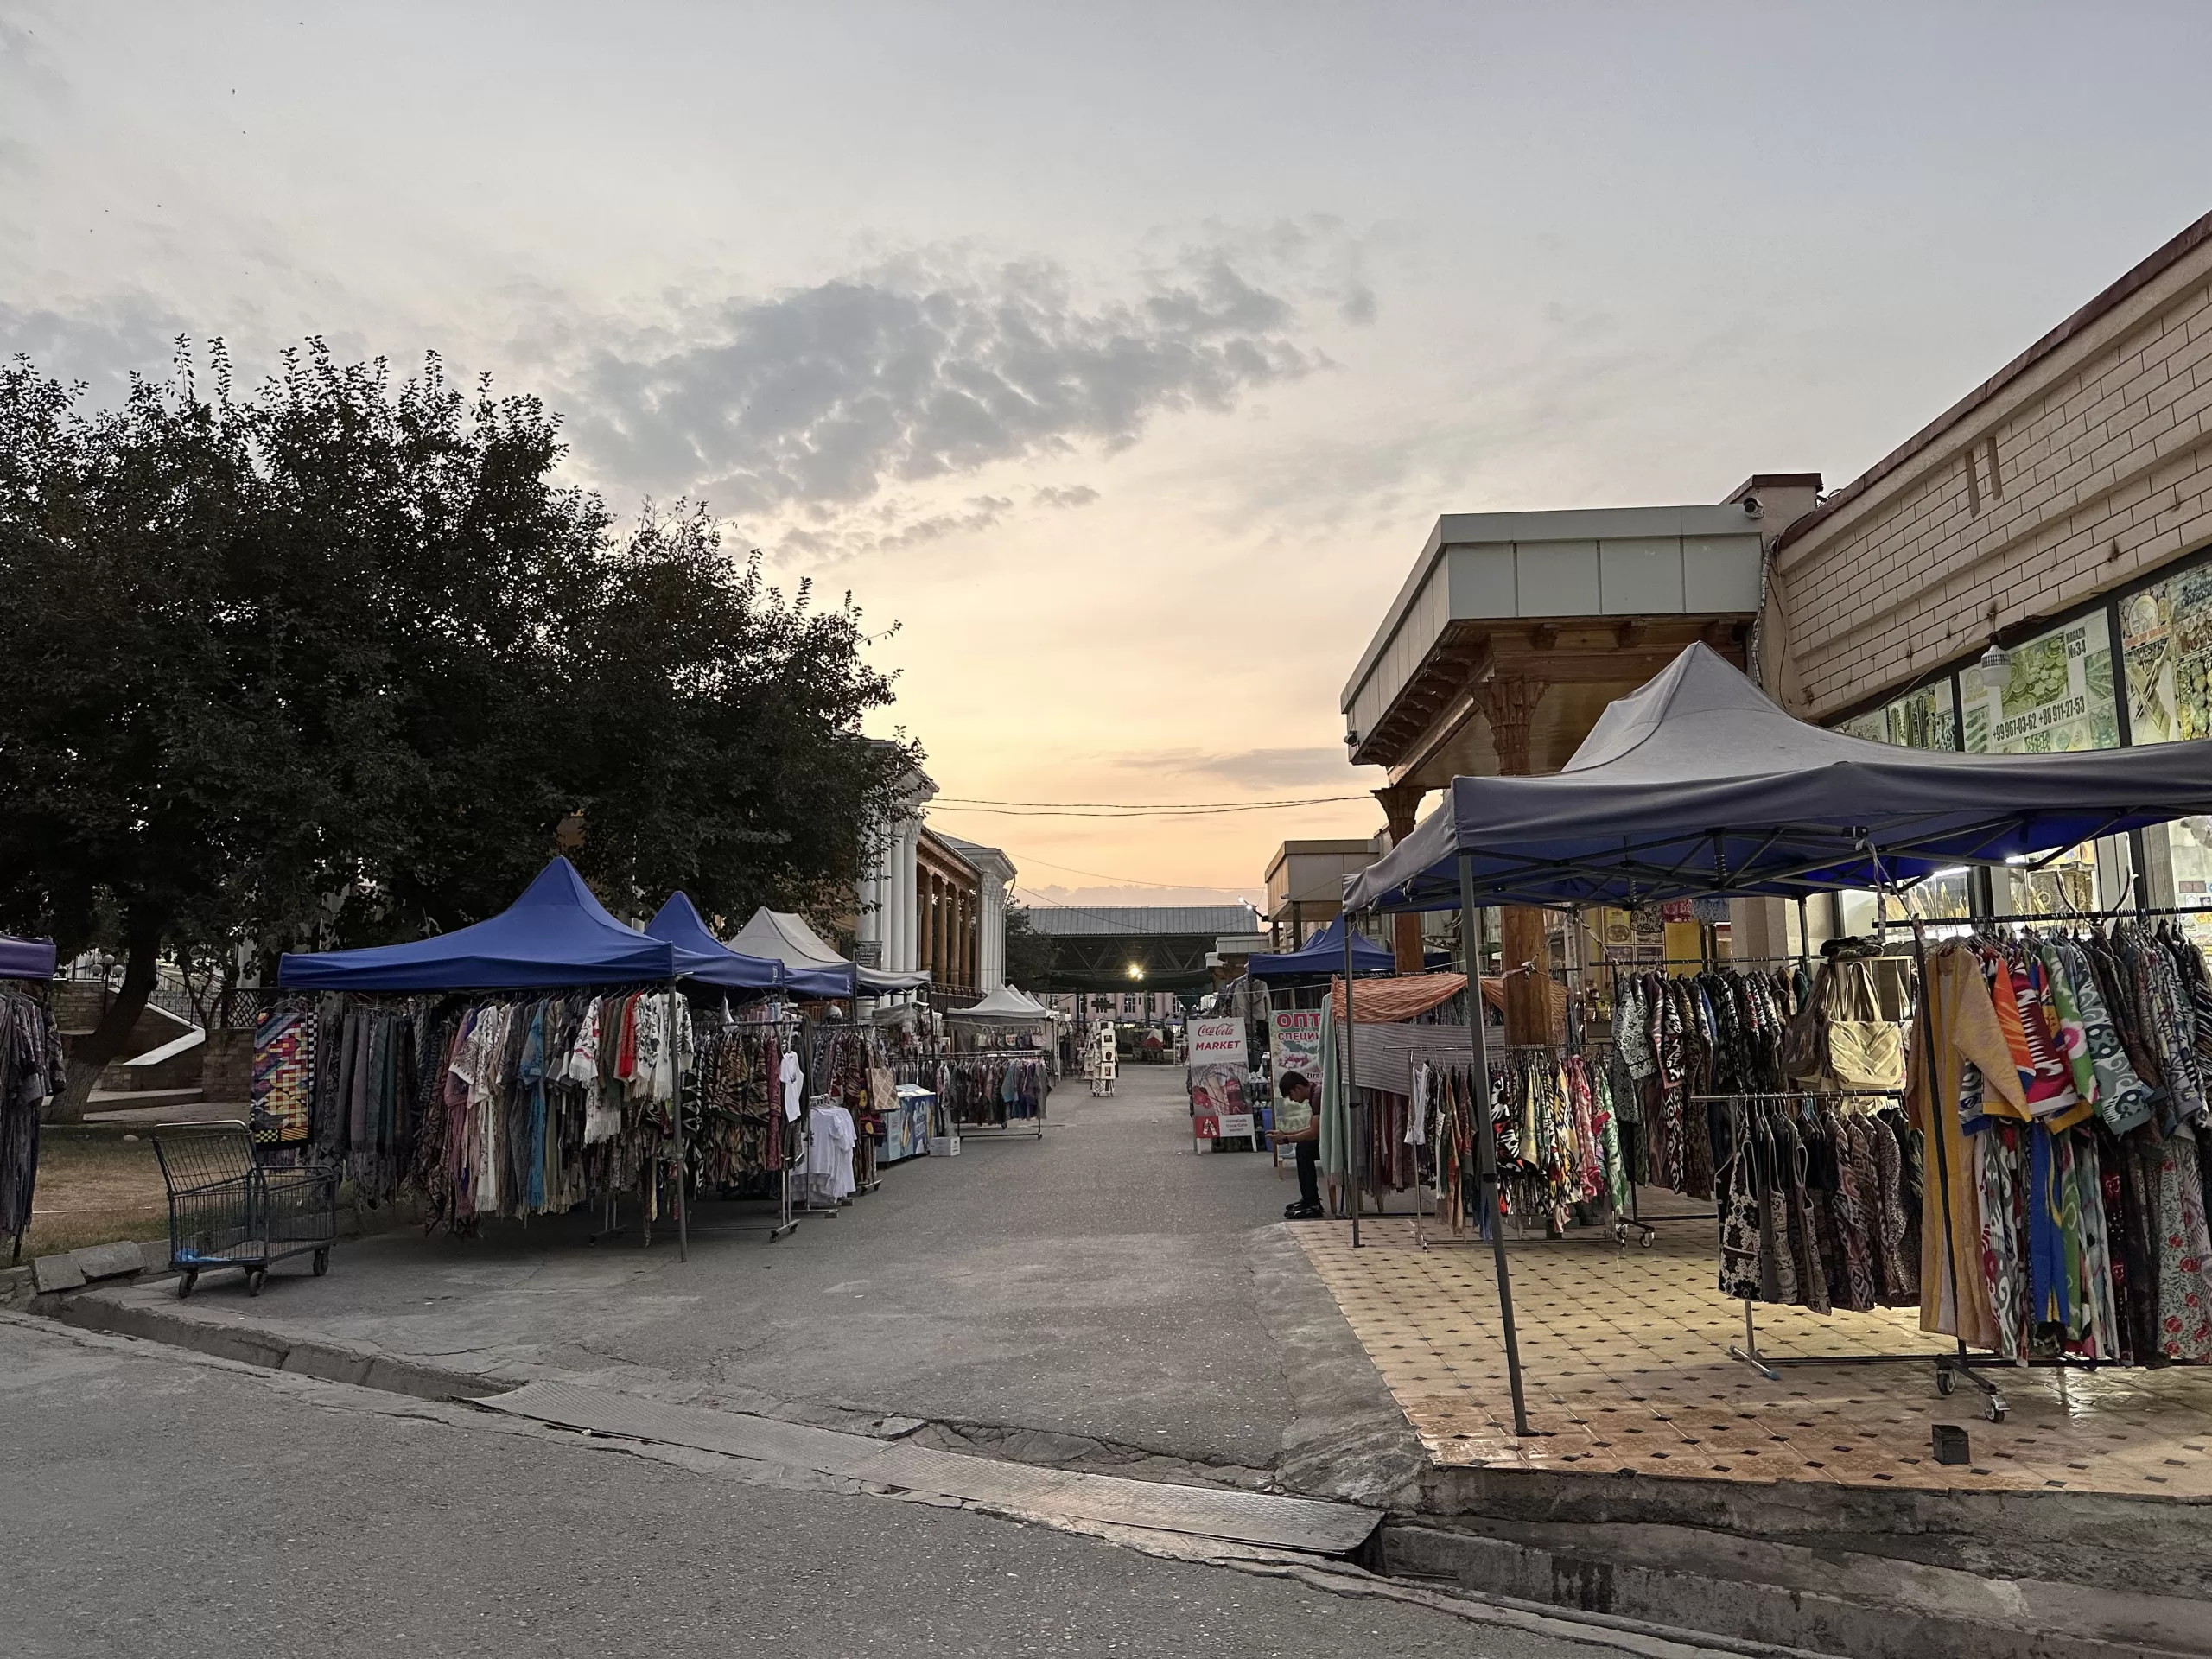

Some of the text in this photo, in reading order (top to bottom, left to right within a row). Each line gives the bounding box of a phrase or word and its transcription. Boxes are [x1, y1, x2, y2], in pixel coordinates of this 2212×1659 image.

[2068, 639, 2087, 659] №34
[1993, 696, 2085, 741] +99 967-03-62 +88 911-27-53
[1195, 1040, 1241, 1051] MARKET
